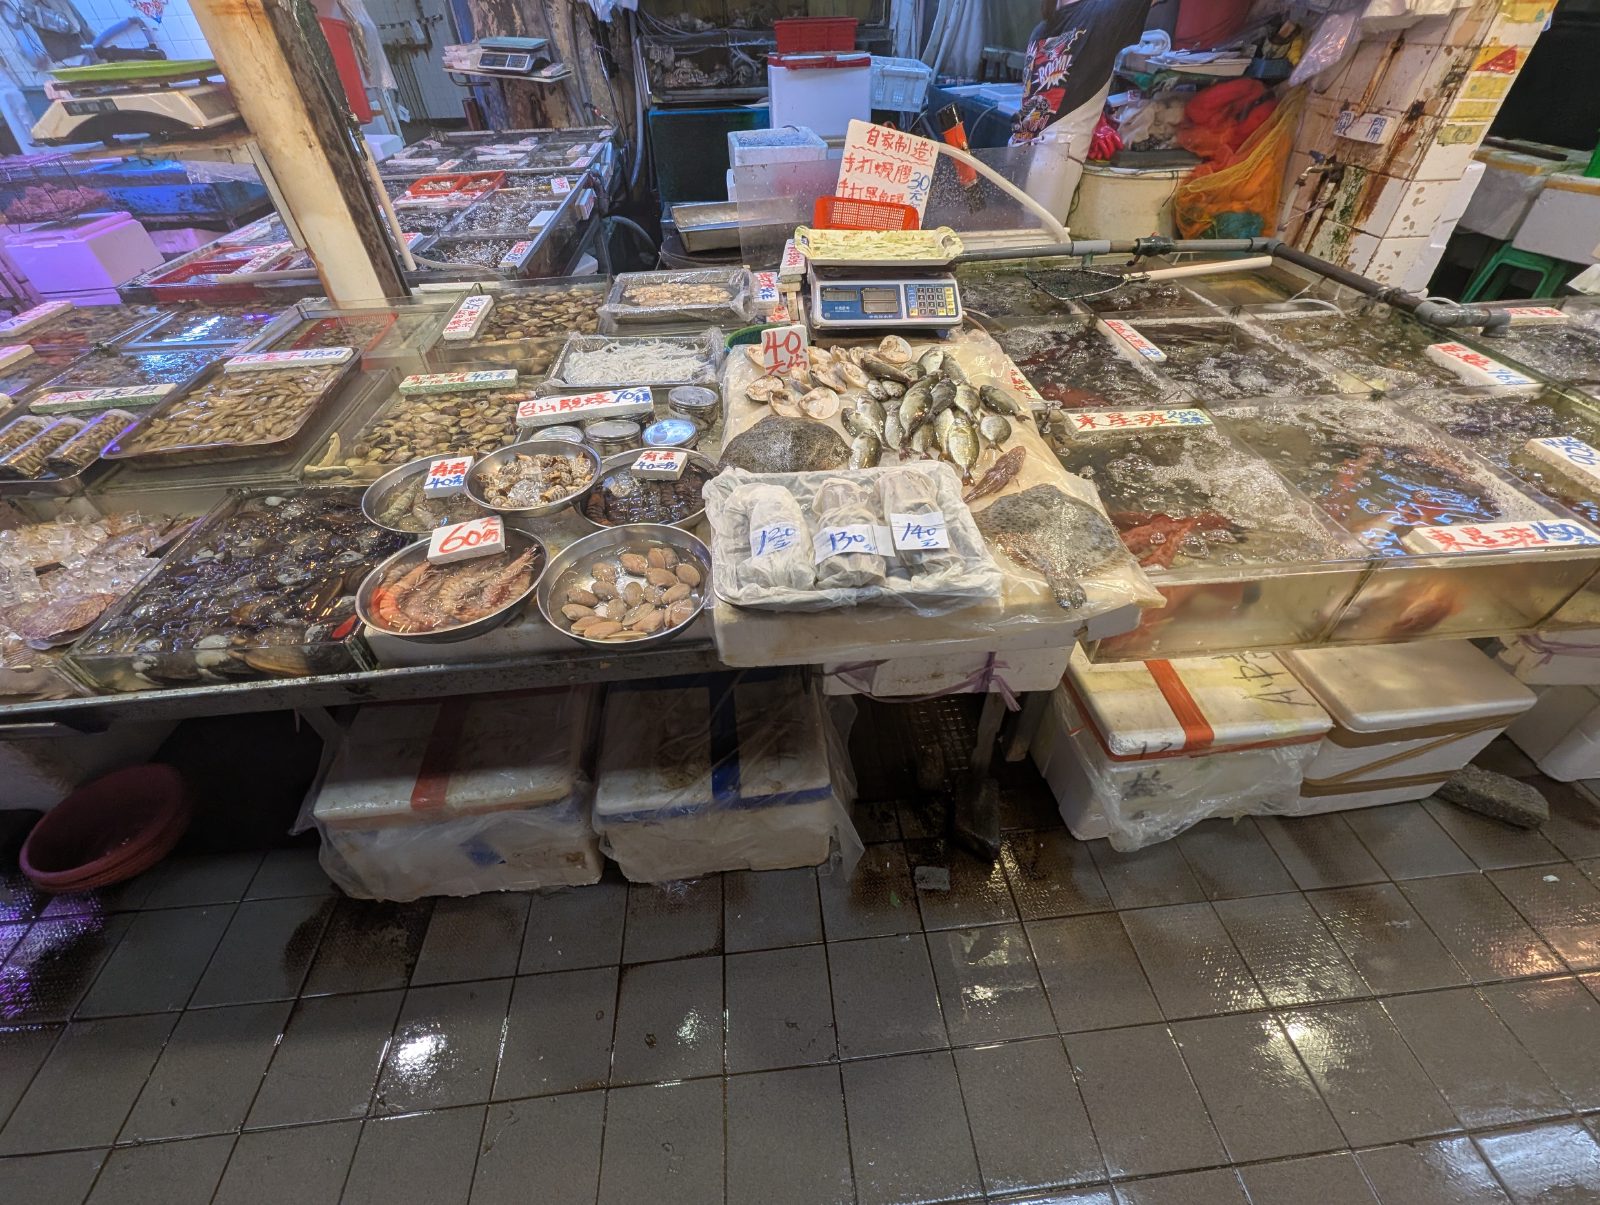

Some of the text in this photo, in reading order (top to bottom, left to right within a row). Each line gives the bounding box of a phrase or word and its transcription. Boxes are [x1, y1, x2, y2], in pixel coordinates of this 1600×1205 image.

[907, 172, 930, 192] 30
[764, 331, 802, 364] 40
[439, 522, 481, 554] 60
[757, 527, 796, 556] 120
[829, 531, 866, 552] 130
[902, 523, 937, 542] 140
